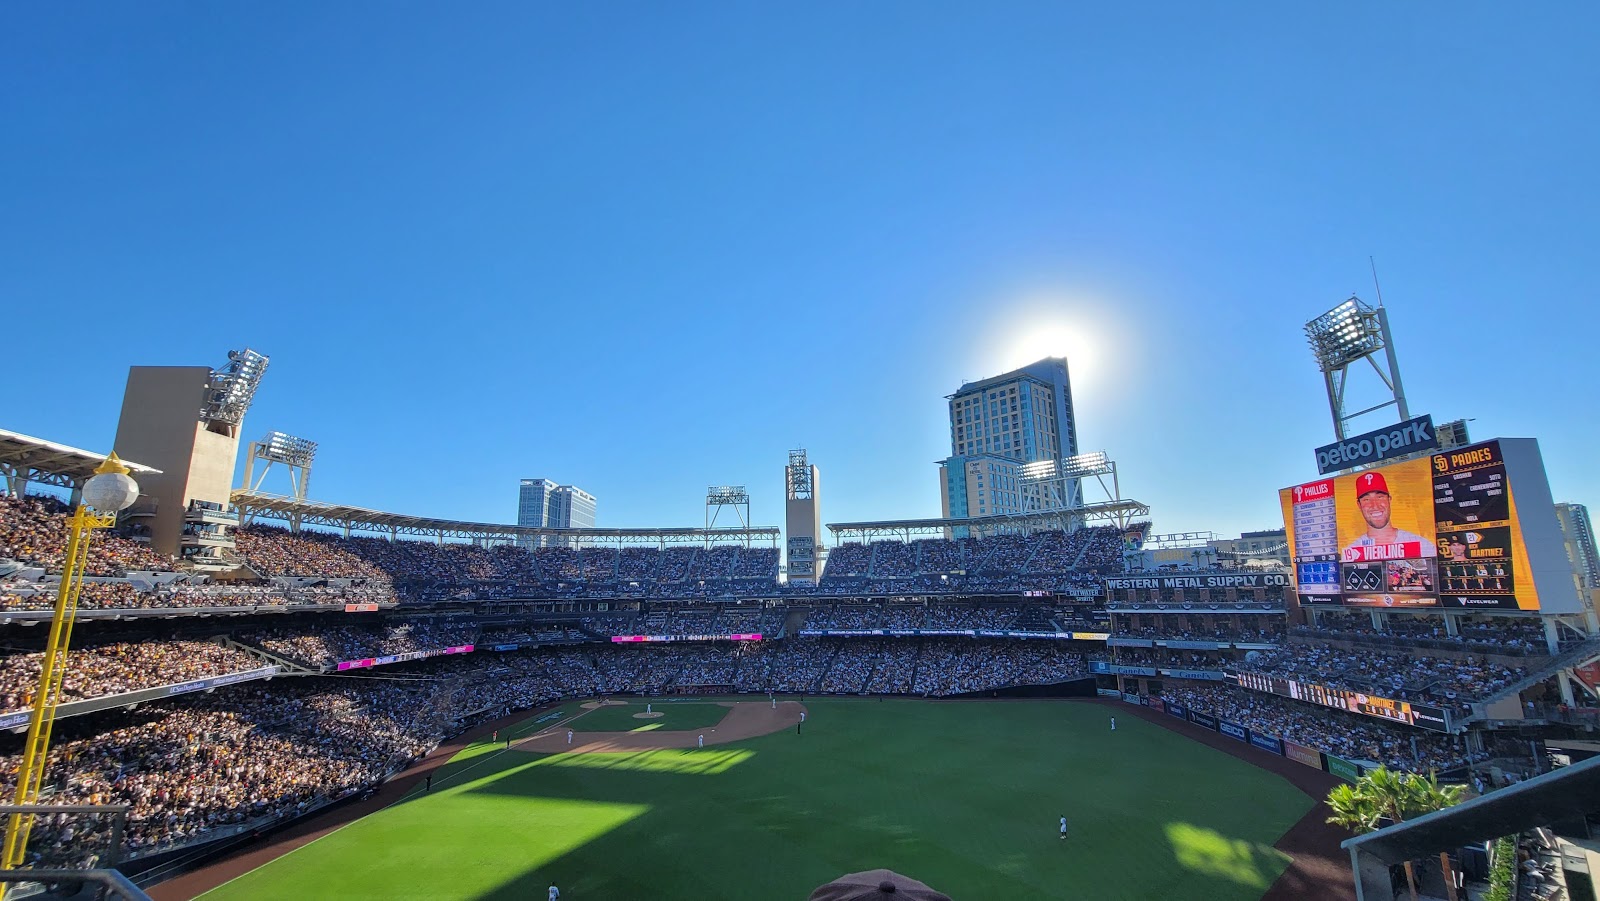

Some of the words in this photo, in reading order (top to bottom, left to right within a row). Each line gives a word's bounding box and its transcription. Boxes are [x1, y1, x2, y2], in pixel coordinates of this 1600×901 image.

[1316, 440, 1373, 473] petco
[1374, 422, 1432, 458] park
[1451, 447, 1492, 467] PADRES
[1304, 483, 1329, 497] PHILLIES
[1344, 549, 1353, 560] 19
[1363, 543, 1405, 560] VIERLING
[1470, 548, 1504, 557] MARTINEZ
[1107, 578, 1159, 589] WESTERN
[1164, 577, 1204, 588] METAL
[1207, 575, 1257, 587] SUPPLY
[1264, 575, 1289, 587] CO.
[1179, 671, 1211, 679] Canel's
[1369, 696, 1395, 710] MARTINEZ
[1220, 722, 1245, 738] GEICO
[1252, 735, 1275, 747] Southwest
[1286, 741, 1319, 764] illumina
